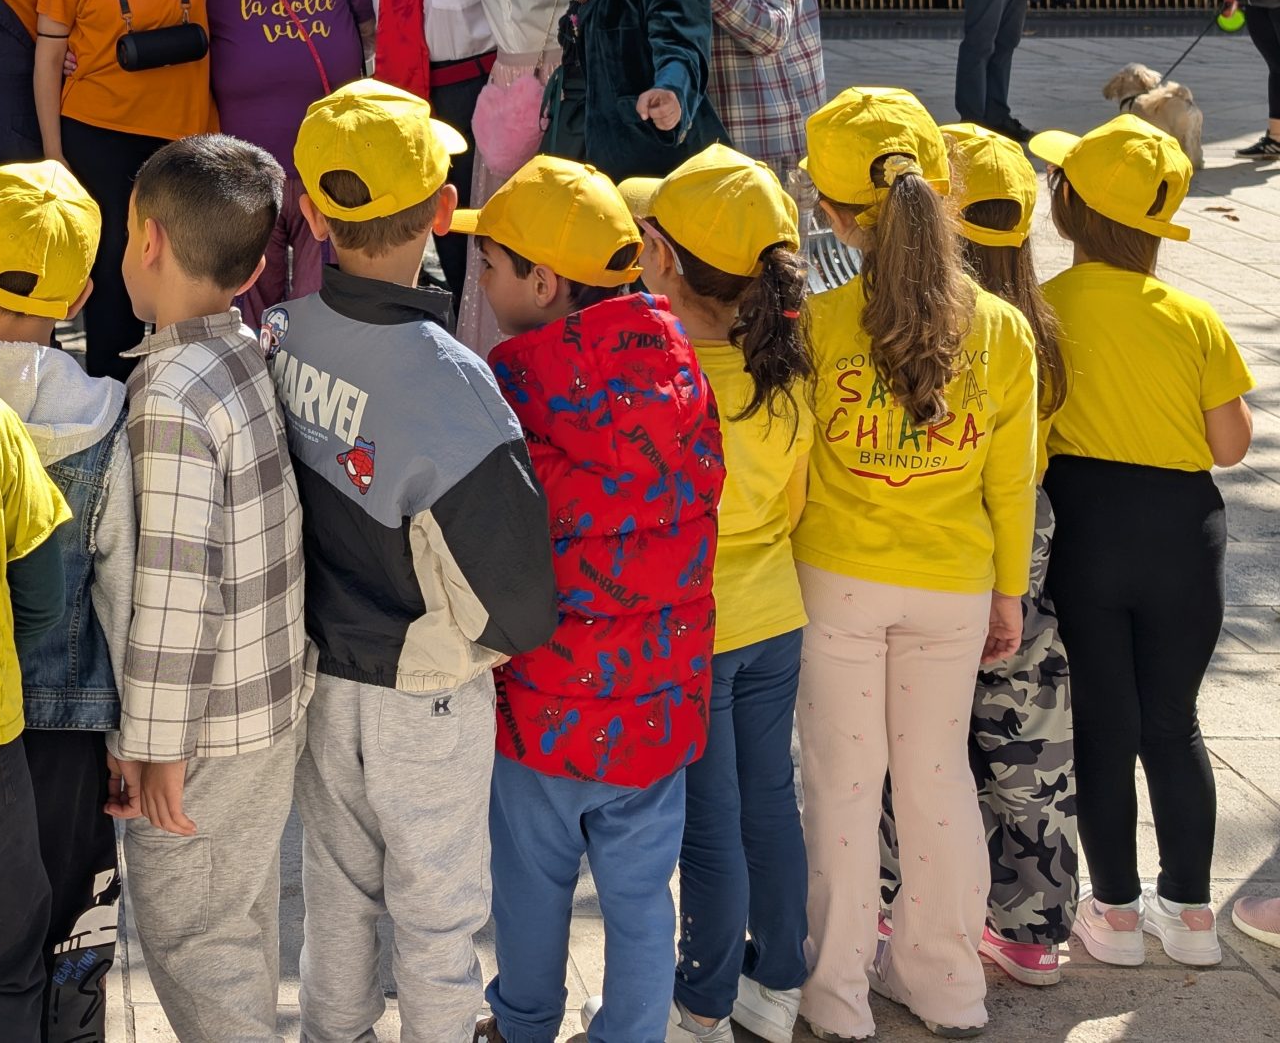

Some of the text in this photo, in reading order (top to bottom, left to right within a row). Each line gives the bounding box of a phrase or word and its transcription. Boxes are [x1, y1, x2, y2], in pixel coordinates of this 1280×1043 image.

[262, 18, 331, 43] vita
[825, 407, 985, 453] CHIARA
[859, 450, 948, 470] BRINDISI
